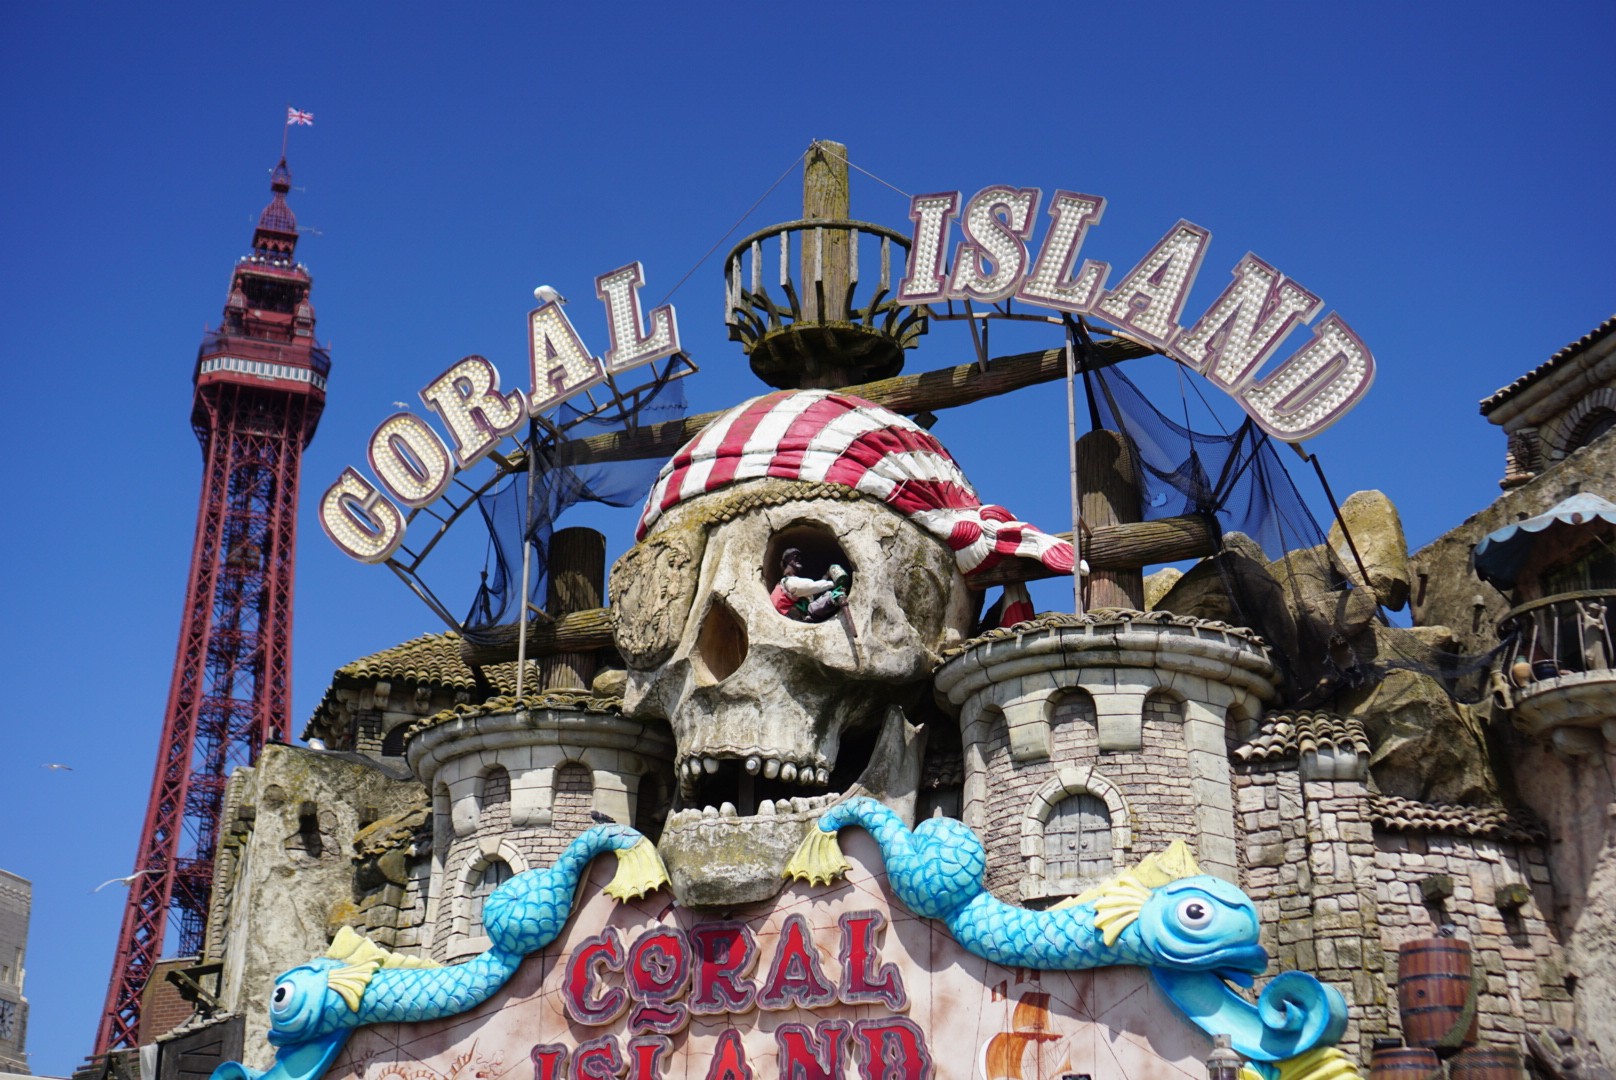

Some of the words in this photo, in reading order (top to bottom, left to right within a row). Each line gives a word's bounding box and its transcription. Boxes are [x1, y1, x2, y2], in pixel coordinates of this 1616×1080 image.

[318, 260, 682, 564] CORAL
[898, 184, 1376, 442] ISLAND
[562, 909, 911, 1034] CORAL
